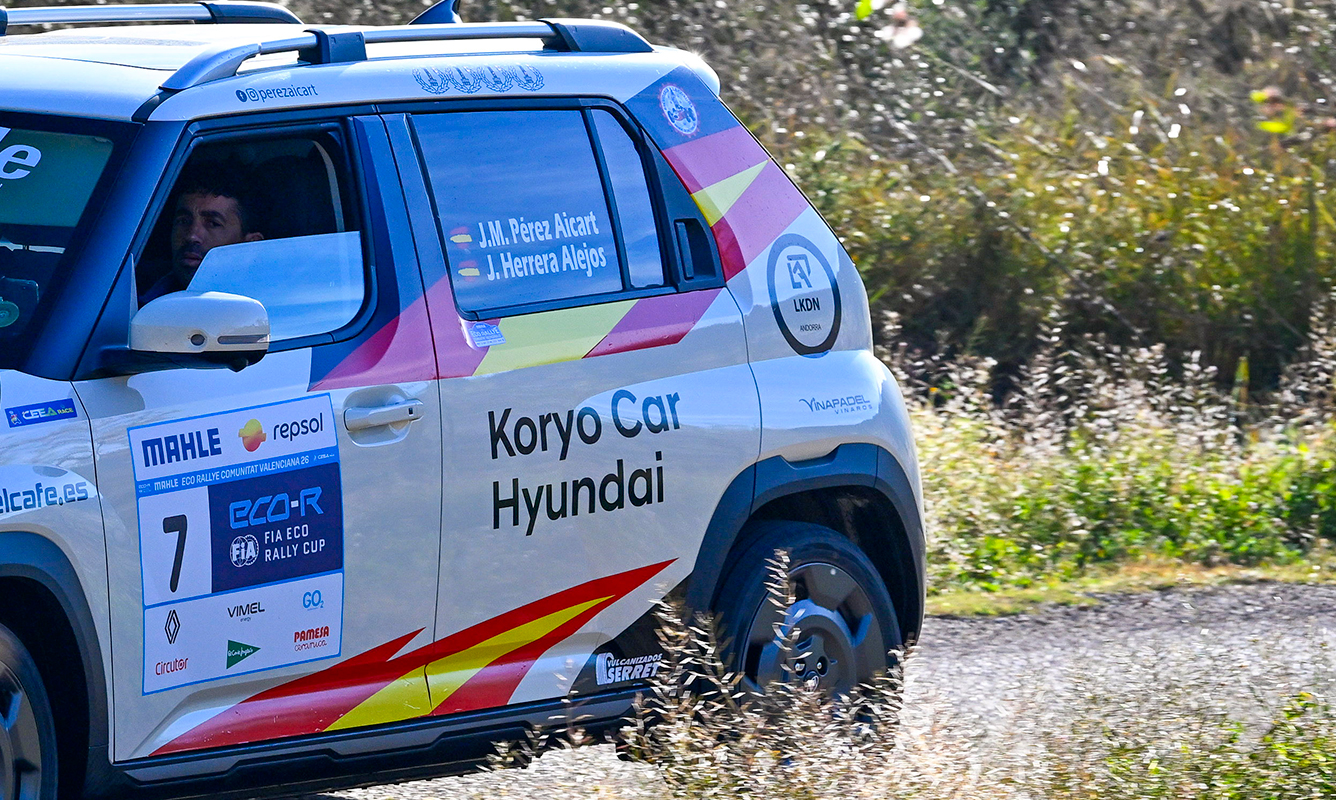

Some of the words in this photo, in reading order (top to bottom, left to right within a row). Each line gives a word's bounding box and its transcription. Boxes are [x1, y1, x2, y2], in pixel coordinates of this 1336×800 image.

[478, 220, 510, 249] J.M.
[508, 217, 553, 244] Pérez
[554, 211, 600, 239] Aicart
[487, 254, 501, 281] J.
[500, 251, 559, 279] Herrera
[561, 243, 607, 278] Alejos
[793, 297, 820, 312] LKDN
[800, 323, 822, 332] ANDORRA
[798, 394, 870, 412] VINAPADEL
[273, 412, 324, 442] repsol
[487, 404, 602, 461] Koryo
[610, 388, 682, 438] Car
[141, 427, 222, 467] MAHLE
[154, 479, 179, 491] MAHLE
[181, 475, 195, 486] ECO
[196, 471, 220, 483] RALLYE
[220, 464, 258, 479] COMUNITAT
[259, 458, 300, 472] VALENCIANA
[300, 455, 310, 465] 26
[492, 451, 664, 536] Hyundai
[264, 530, 283, 544] FIA
[286, 524, 310, 540] ECO
[162, 514, 188, 593] 7
[264, 543, 299, 562] RALLY
[303, 539, 326, 555] CUP
[227, 602, 265, 618] VIMEL
[293, 625, 330, 643] PAMESA
[155, 658, 189, 675] Circutor
[607, 653, 663, 667] VULCANIZADOS
[607, 661, 661, 682] SERRET
